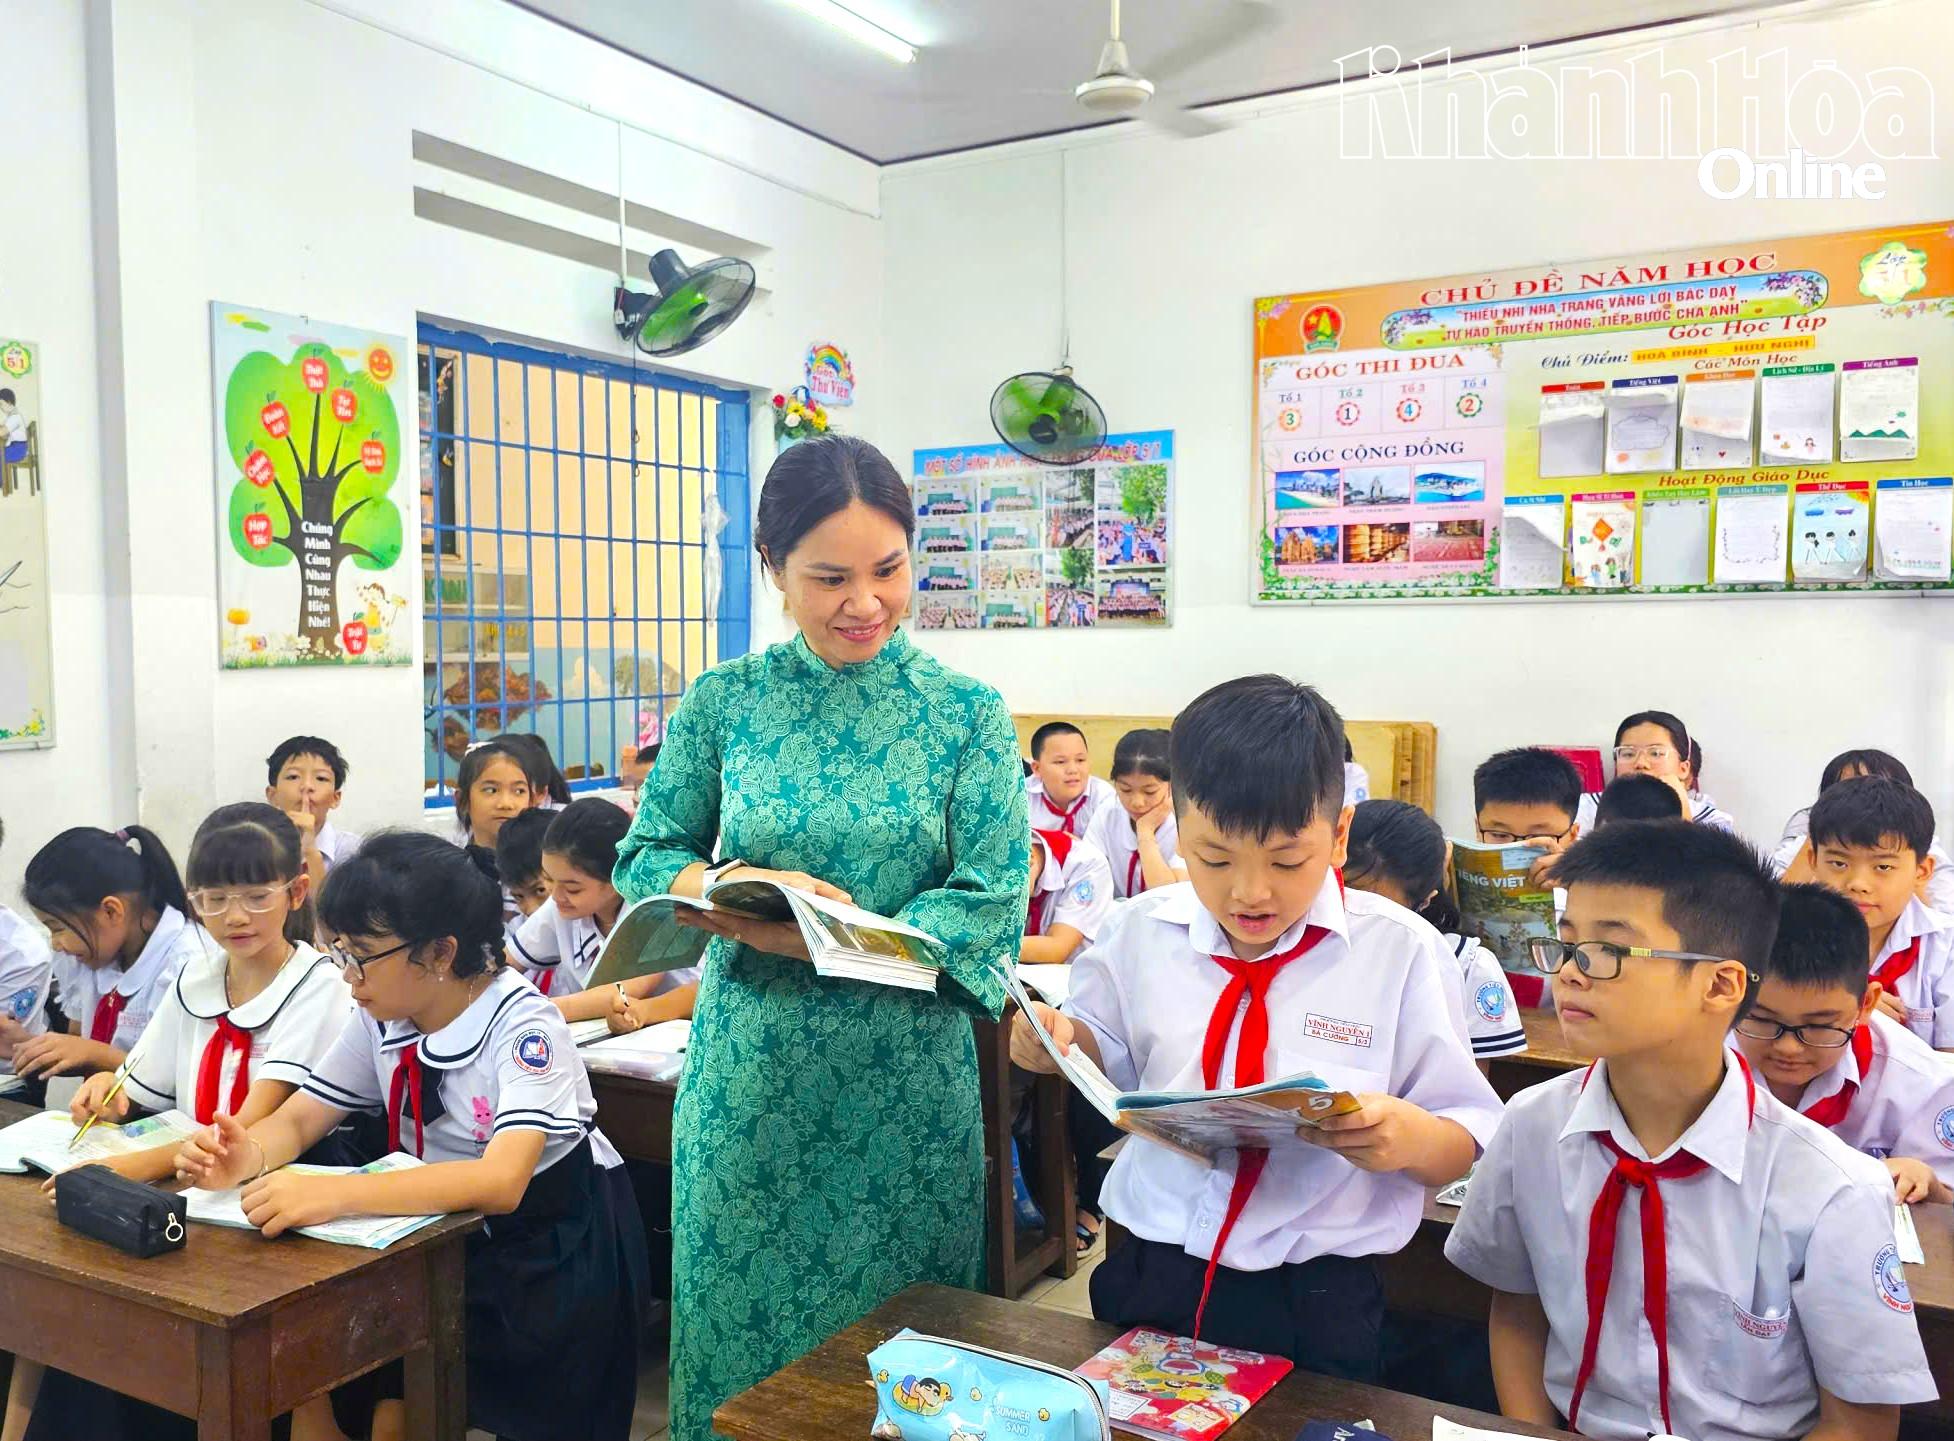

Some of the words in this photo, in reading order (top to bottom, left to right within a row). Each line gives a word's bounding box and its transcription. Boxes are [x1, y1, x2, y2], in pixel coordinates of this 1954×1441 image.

[1420, 278, 1498, 306] CHỦ
[1513, 268, 1563, 297] ĐỀ
[1579, 264, 1668, 290] NĂM
[1686, 253, 1777, 278] HỌC
[1502, 306, 1525, 317] NHI
[1529, 303, 1556, 315] NHA
[1560, 298, 1604, 312] TRANG
[1676, 288, 1704, 301] BÁC
[1709, 286, 1737, 300] DẠY
[1676, 307, 1704, 320] CHA
[1668, 324, 1714, 340] Góc
[1723, 318, 1771, 337] Học
[1780, 314, 1827, 333] Tập
[1295, 358, 1347, 381] GÓC
[1355, 359, 1399, 376] THI
[1410, 353, 1465, 371] ĐUA
[1767, 353, 1798, 366] Học
[1480, 378, 1487, 387] 4
[1356, 389, 1363, 397] 2
[1404, 403, 1413, 416] 4
[1465, 399, 1474, 412] 2
[1286, 412, 1295, 426] 3
[1344, 407, 1351, 420] 1
[1293, 447, 1335, 464] GÓC
[1341, 443, 1398, 463] CỘNG
[1405, 436, 1465, 457] ĐỒNG
[1658, 476, 1697, 488] Hoạt
[1703, 471, 1745, 486] Động
[1751, 471, 1790, 483] Giáo
[1796, 469, 1830, 482] Dục
[301, 520, 334, 537] Chúng
[304, 537, 331, 550] Mình
[305, 568, 332, 581] Nhau
[306, 584, 331, 599] Thực
[307, 600, 331, 614] Hiện
[1492, 874, 1526, 889] VIỆT
[1307, 1095, 1334, 1111] 5
[995, 1406, 1031, 1423] SUMMER
[1006, 1421, 1030, 1437] SAND
